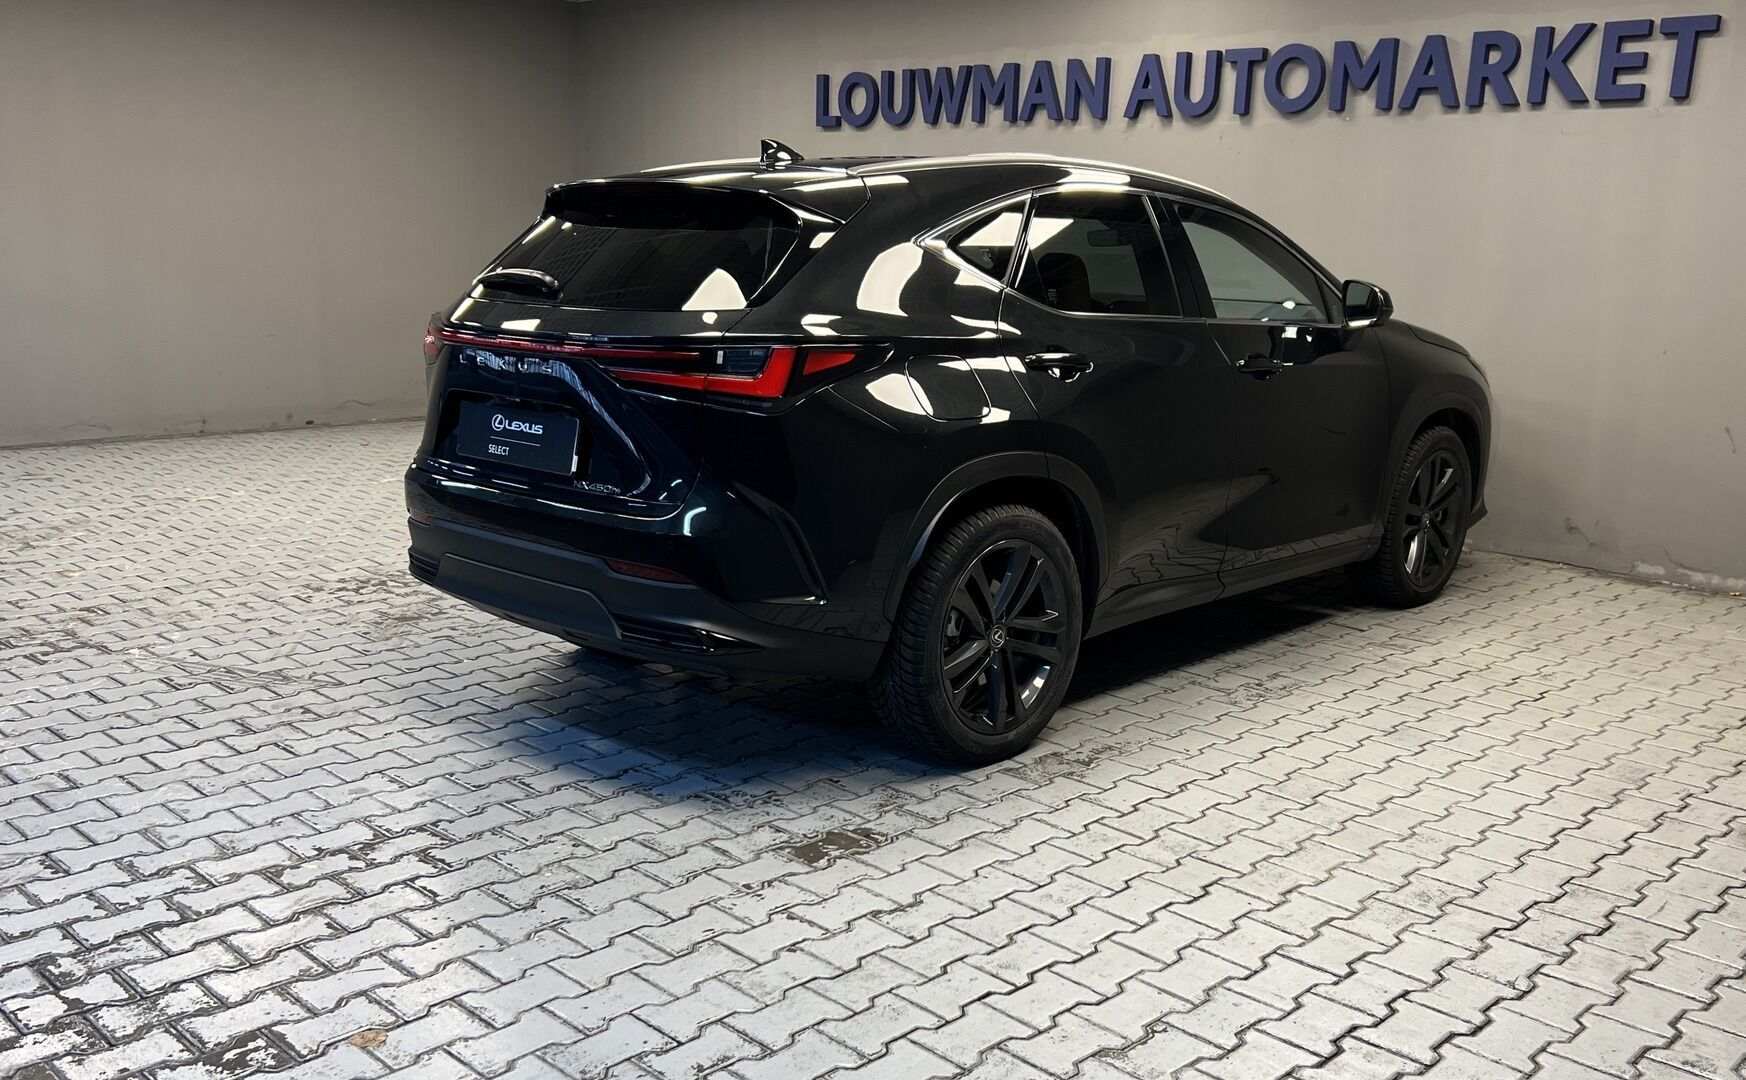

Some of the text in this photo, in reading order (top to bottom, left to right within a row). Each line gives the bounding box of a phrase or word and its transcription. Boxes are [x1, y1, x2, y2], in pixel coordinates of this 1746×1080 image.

[815, 14, 1722, 128] LOUWMAN AUTOMARKET
[505, 419, 543, 434] LEXUS
[488, 443, 510, 456] SELECT
